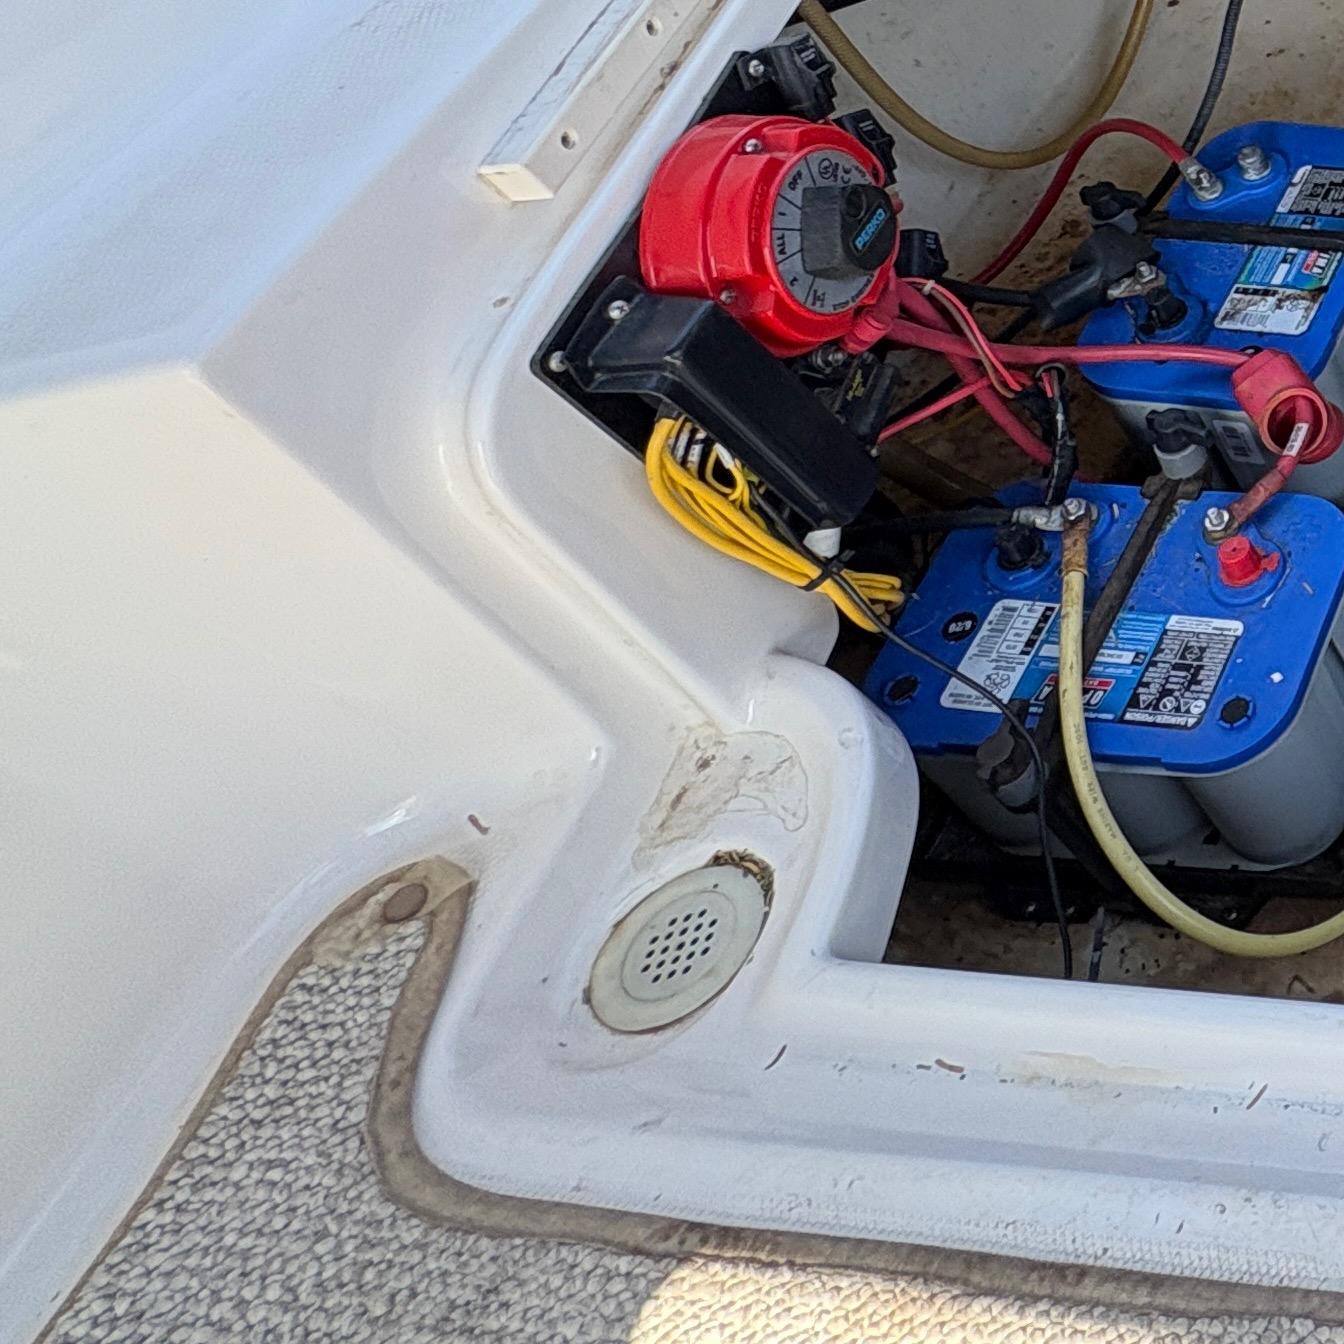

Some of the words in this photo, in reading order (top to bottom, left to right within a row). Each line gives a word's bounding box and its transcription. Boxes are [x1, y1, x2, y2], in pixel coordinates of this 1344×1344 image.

[788, 170, 803, 191] OFF
[854, 207, 887, 251] PERKO
[776, 233, 787, 256] ALL
